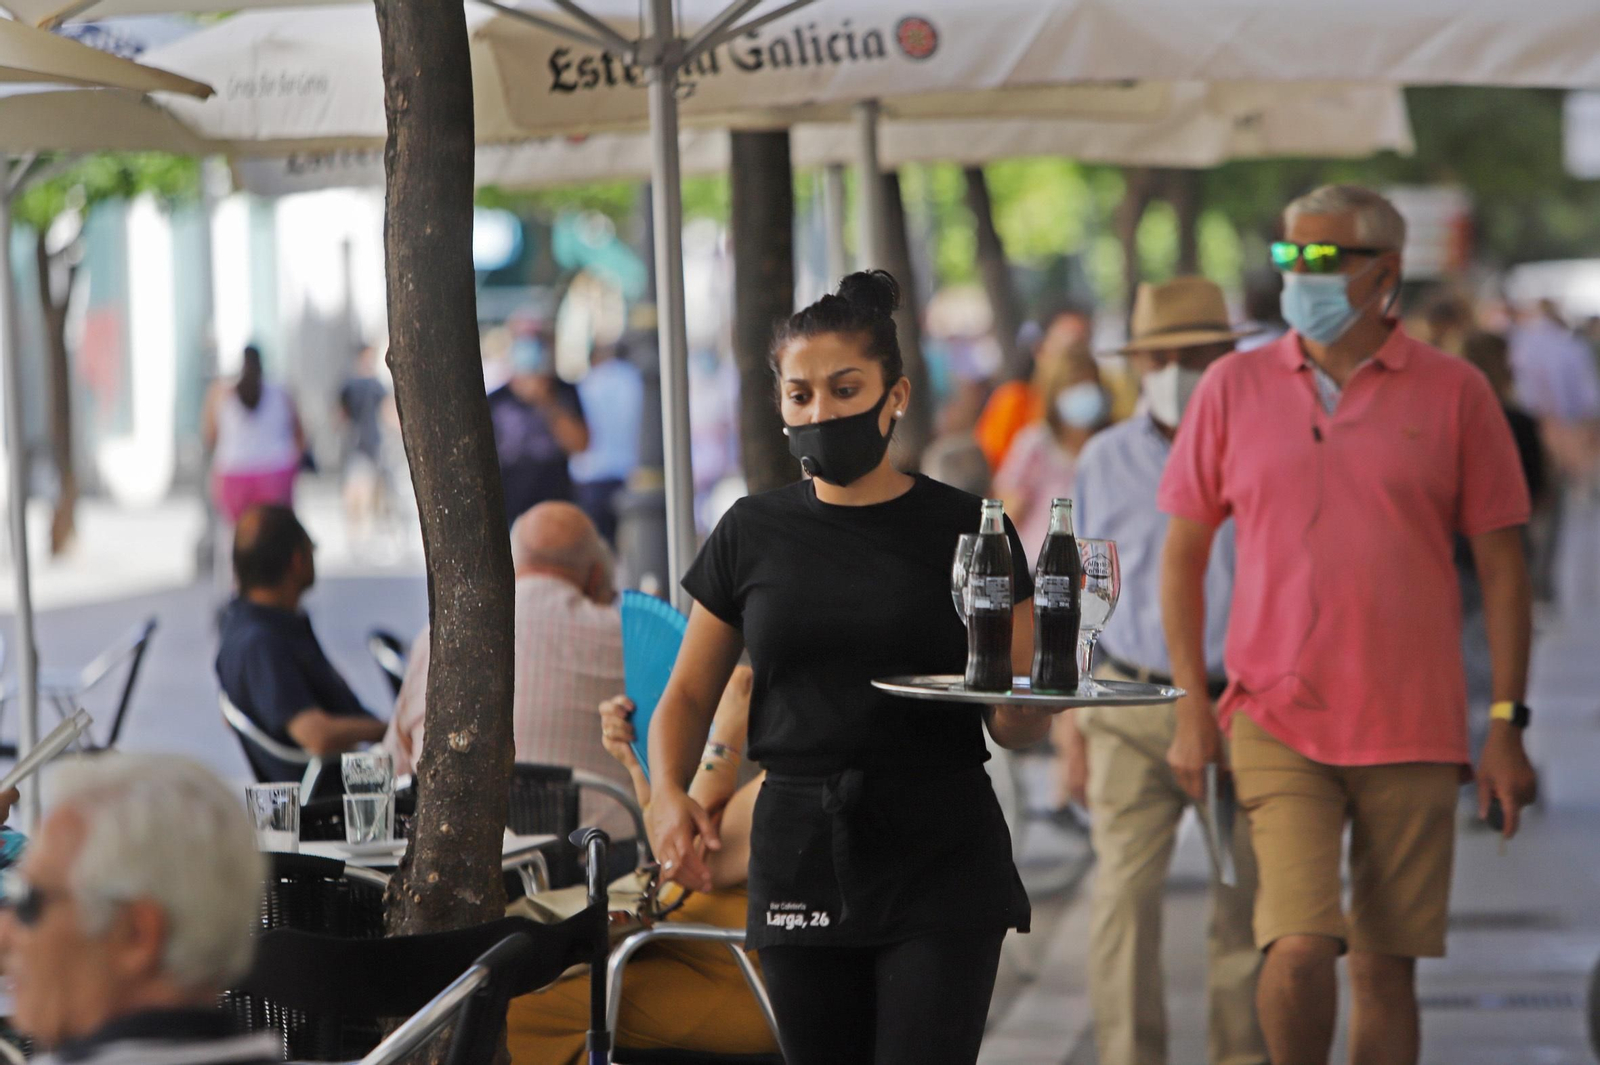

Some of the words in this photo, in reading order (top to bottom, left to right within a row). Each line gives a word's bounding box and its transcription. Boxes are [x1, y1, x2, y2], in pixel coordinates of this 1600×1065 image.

[727, 17, 887, 73] Galicia
[766, 911, 808, 930] Larga,
[810, 911, 830, 927] 26
